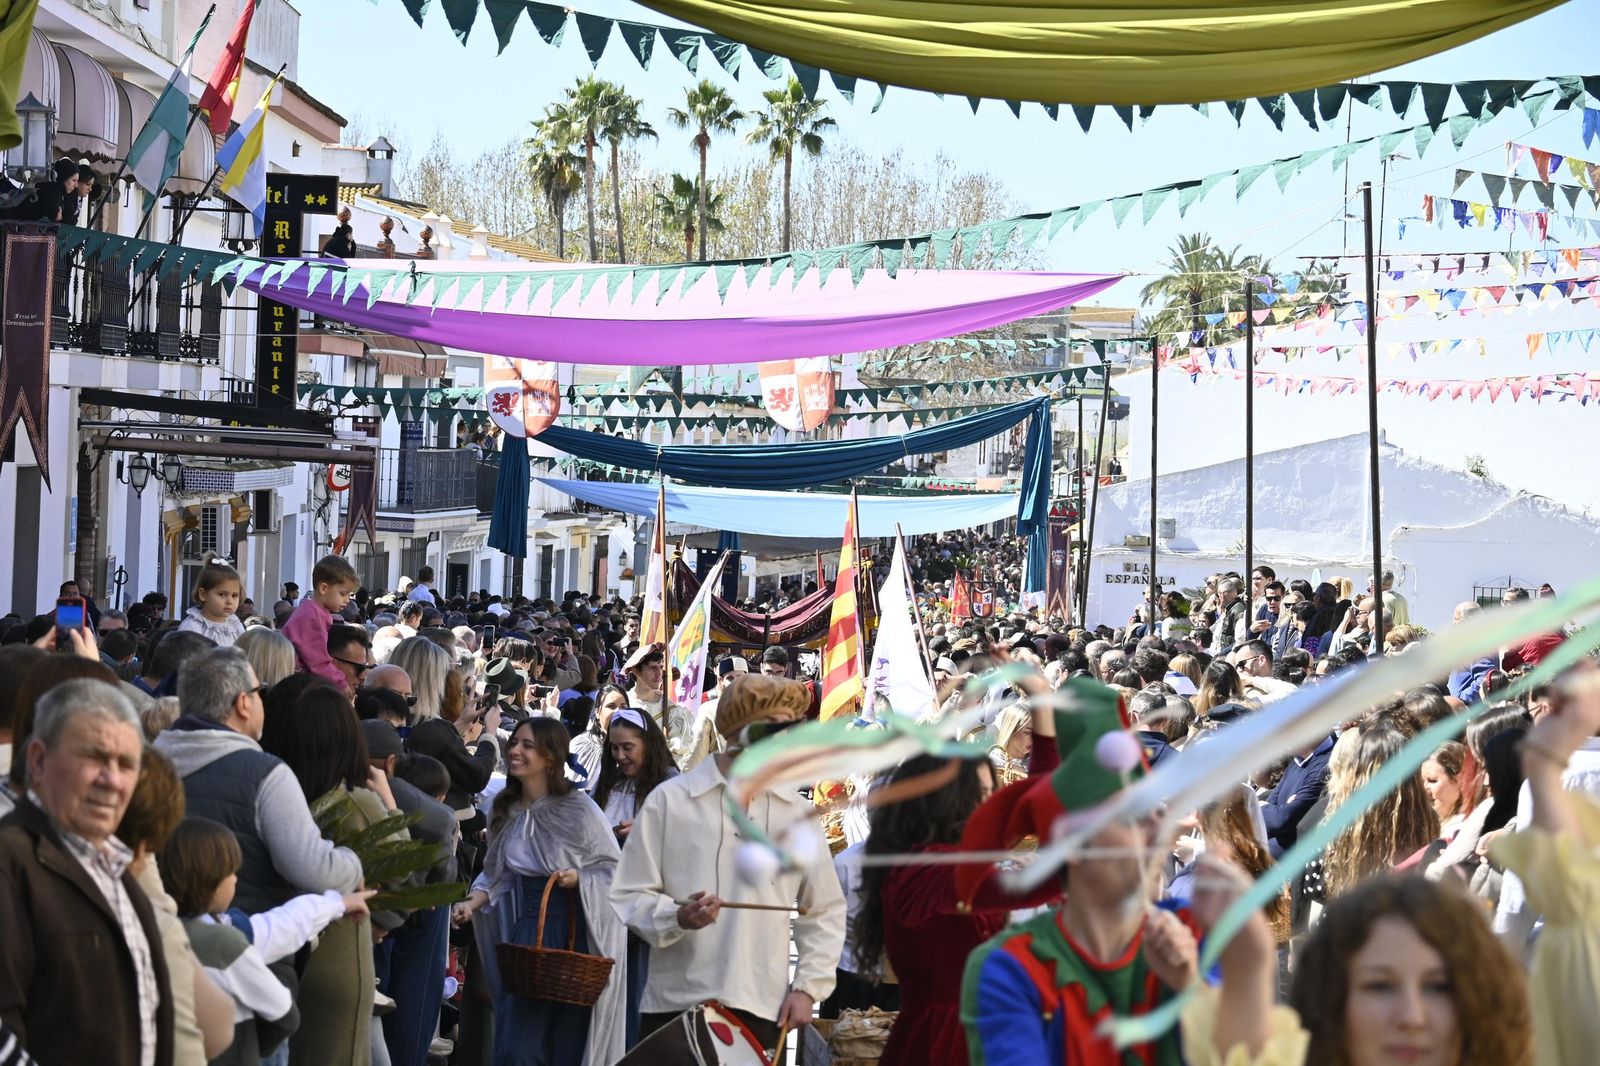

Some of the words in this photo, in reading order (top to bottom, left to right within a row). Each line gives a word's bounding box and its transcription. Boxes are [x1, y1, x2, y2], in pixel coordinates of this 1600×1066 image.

[265, 185, 289, 205] tel
[271, 220, 291, 395] Reurante
[1134, 563, 1150, 572] LA
[1105, 572, 1176, 585] ESPAÑLA
